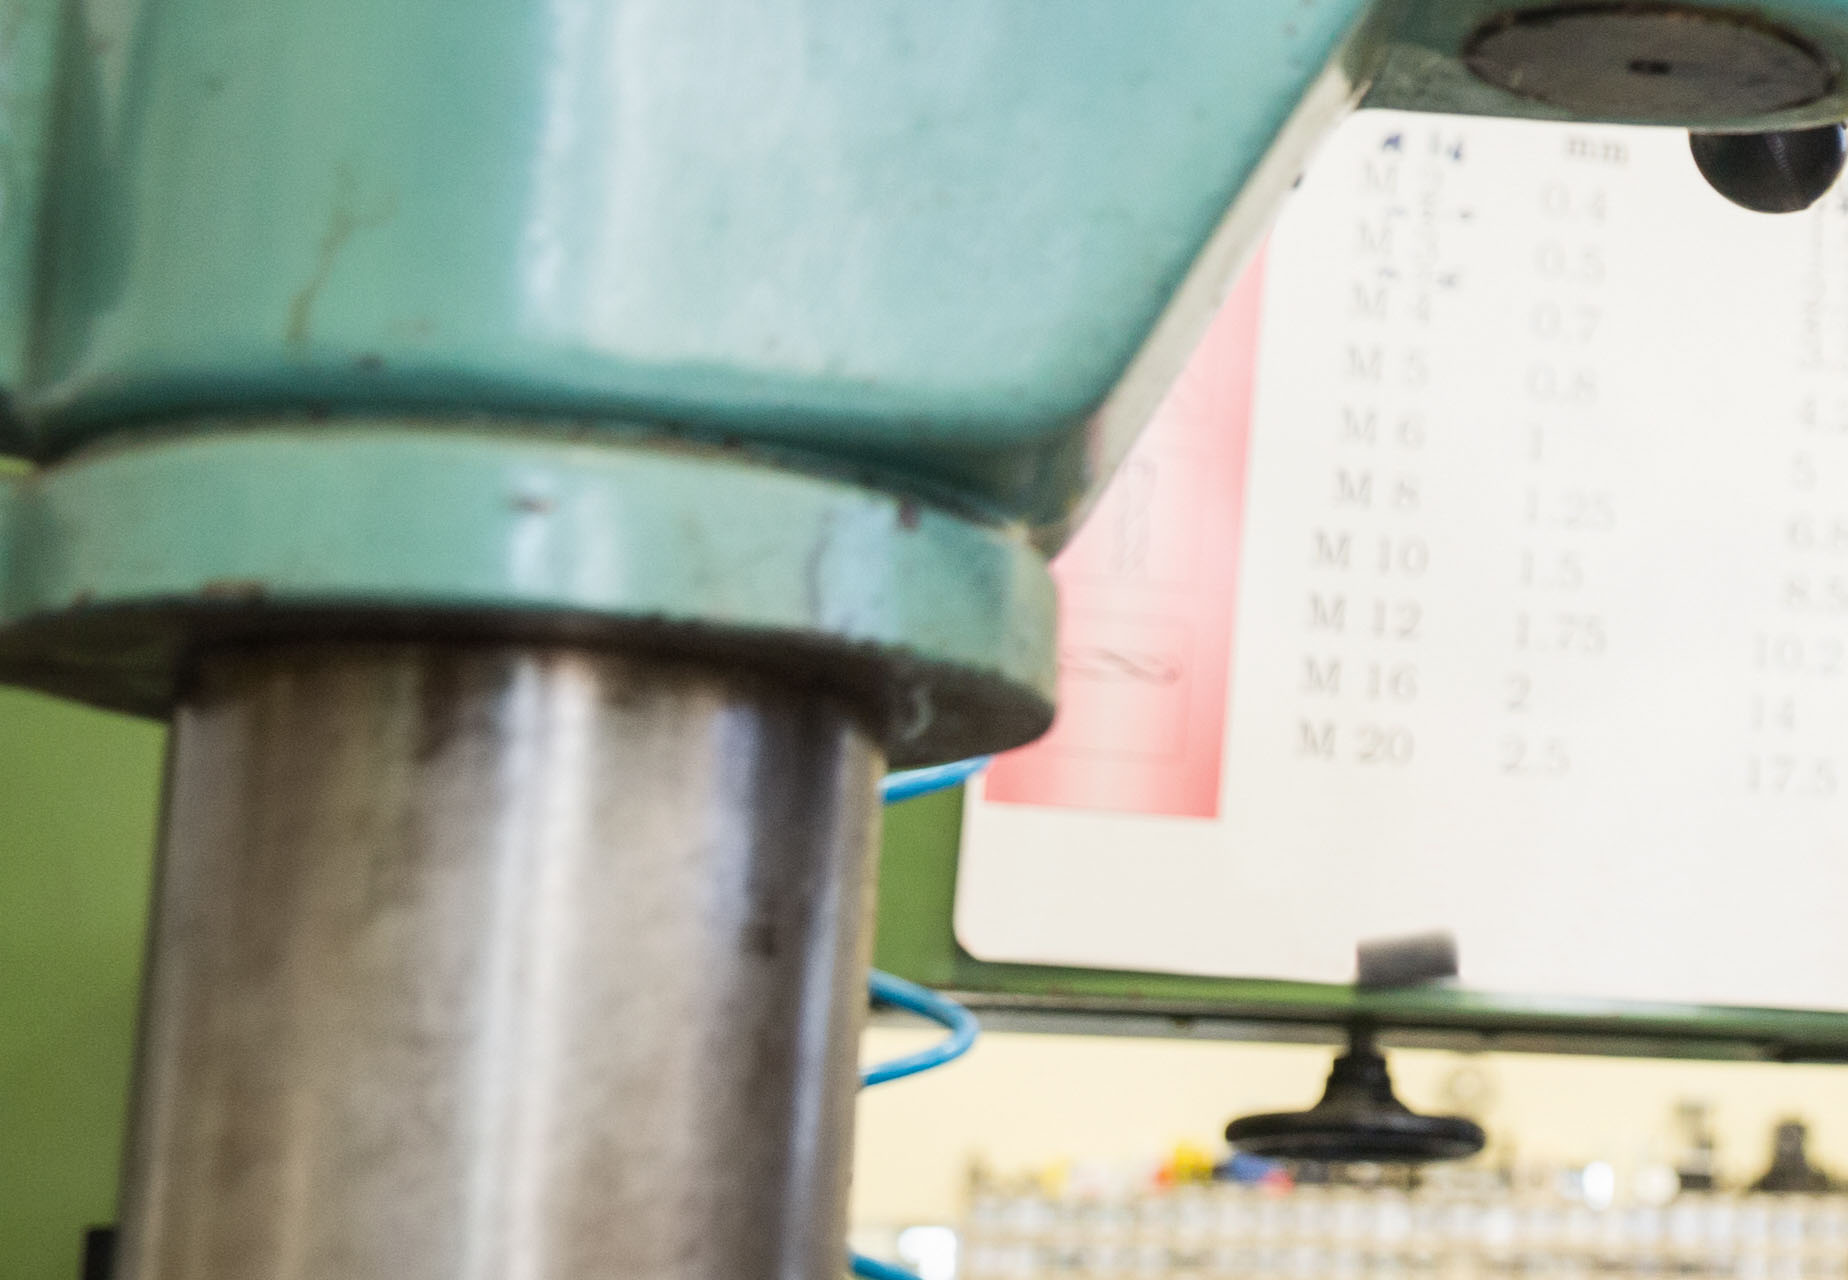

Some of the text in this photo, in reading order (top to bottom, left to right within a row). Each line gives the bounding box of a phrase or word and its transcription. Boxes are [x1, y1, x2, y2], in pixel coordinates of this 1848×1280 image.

[1564, 134, 1629, 166] mm
[1360, 158, 1399, 197] M
[1354, 217, 1393, 257] M
[1348, 279, 1389, 323] M
[1527, 299, 1605, 344] 0.7
[1343, 342, 1385, 385] M
[1400, 347, 1431, 389] 5
[1338, 404, 1380, 447] M
[1395, 408, 1428, 451] 6
[1332, 465, 1374, 510] M
[1309, 527, 1353, 571] M
[1376, 533, 1430, 578] 10
[1518, 547, 1586, 592] 1.5
[1304, 589, 1348, 635] M
[1370, 596, 1423, 642] 12
[1513, 609, 1608, 656] 1.75
[1298, 652, 1343, 698] M
[1364, 659, 1418, 705] 16
[1502, 670, 1533, 715] 2
[1294, 716, 1337, 761] M
[1355, 721, 1415, 767] 20
[1498, 732, 1572, 778] 2.5
